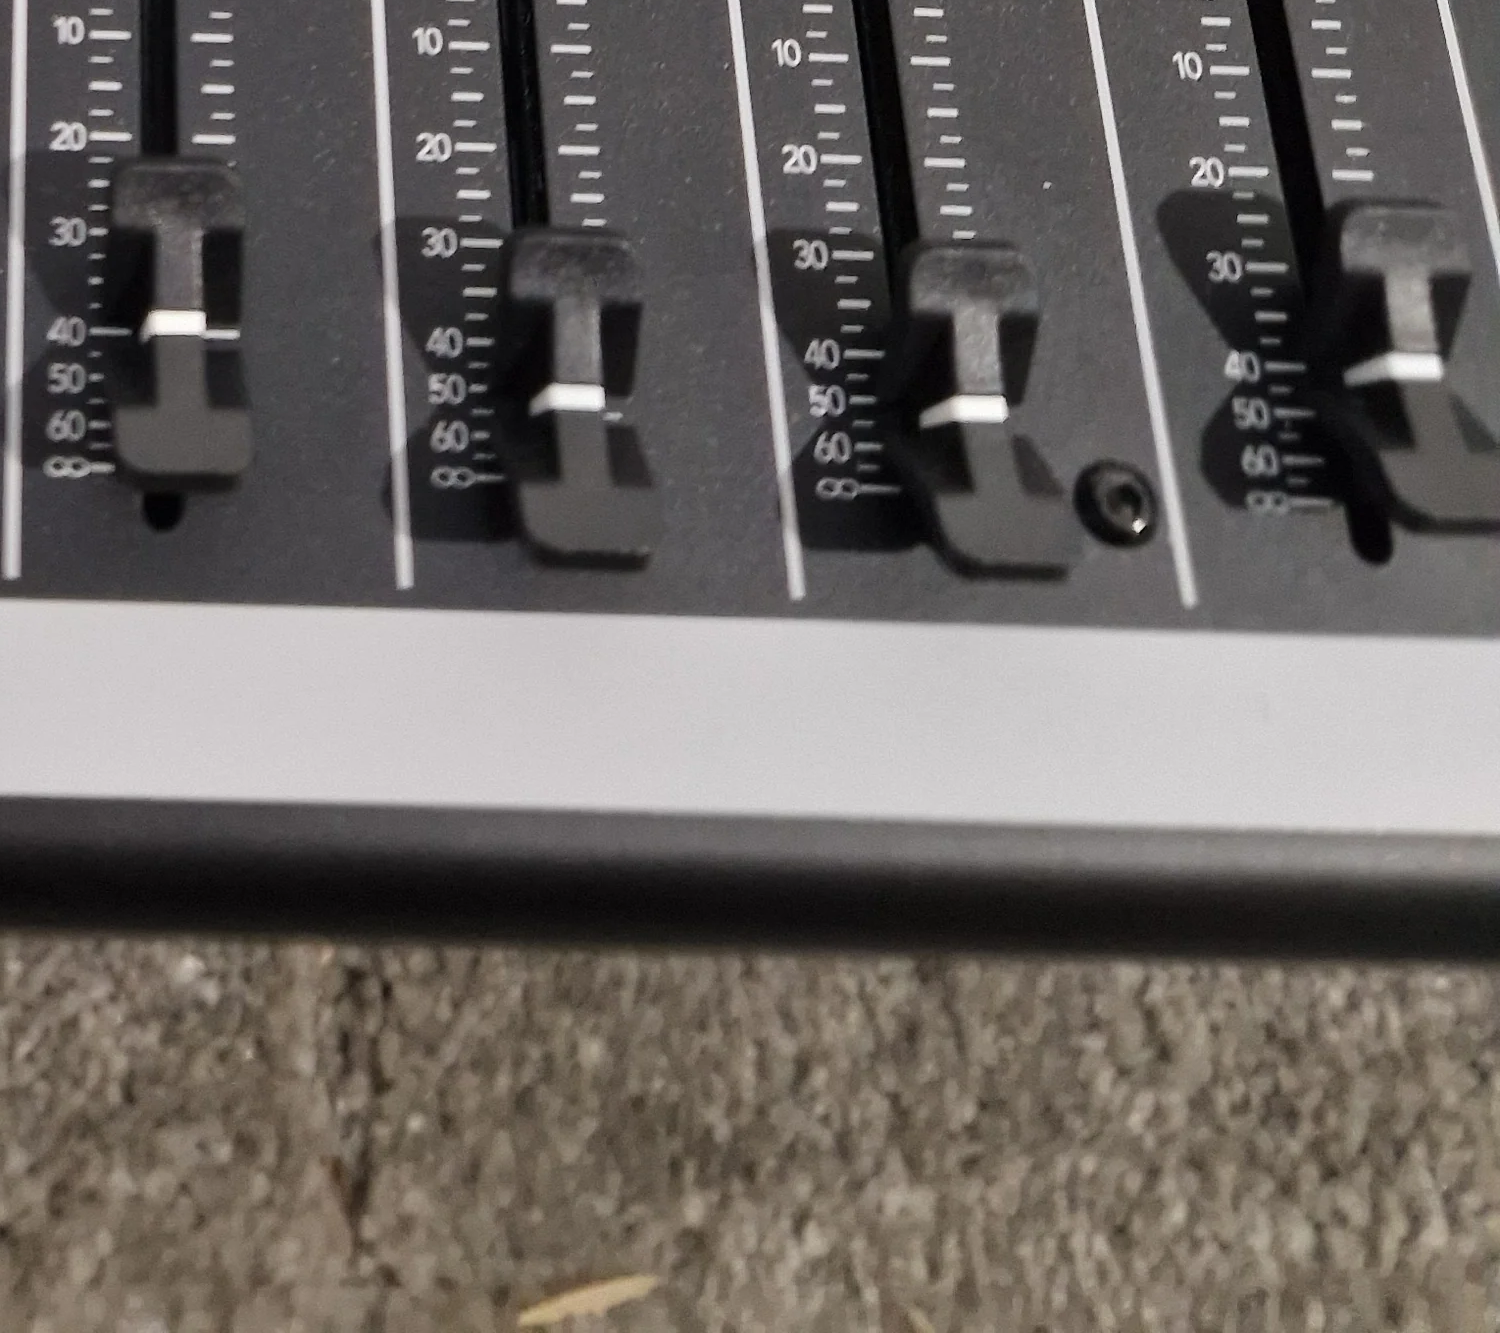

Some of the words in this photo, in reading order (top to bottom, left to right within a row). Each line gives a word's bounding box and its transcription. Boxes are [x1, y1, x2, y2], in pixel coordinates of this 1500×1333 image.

[1173, 53, 1202, 80] 10
[416, 133, 452, 162] 20
[1189, 158, 1225, 188] 20
[793, 240, 829, 270] 30
